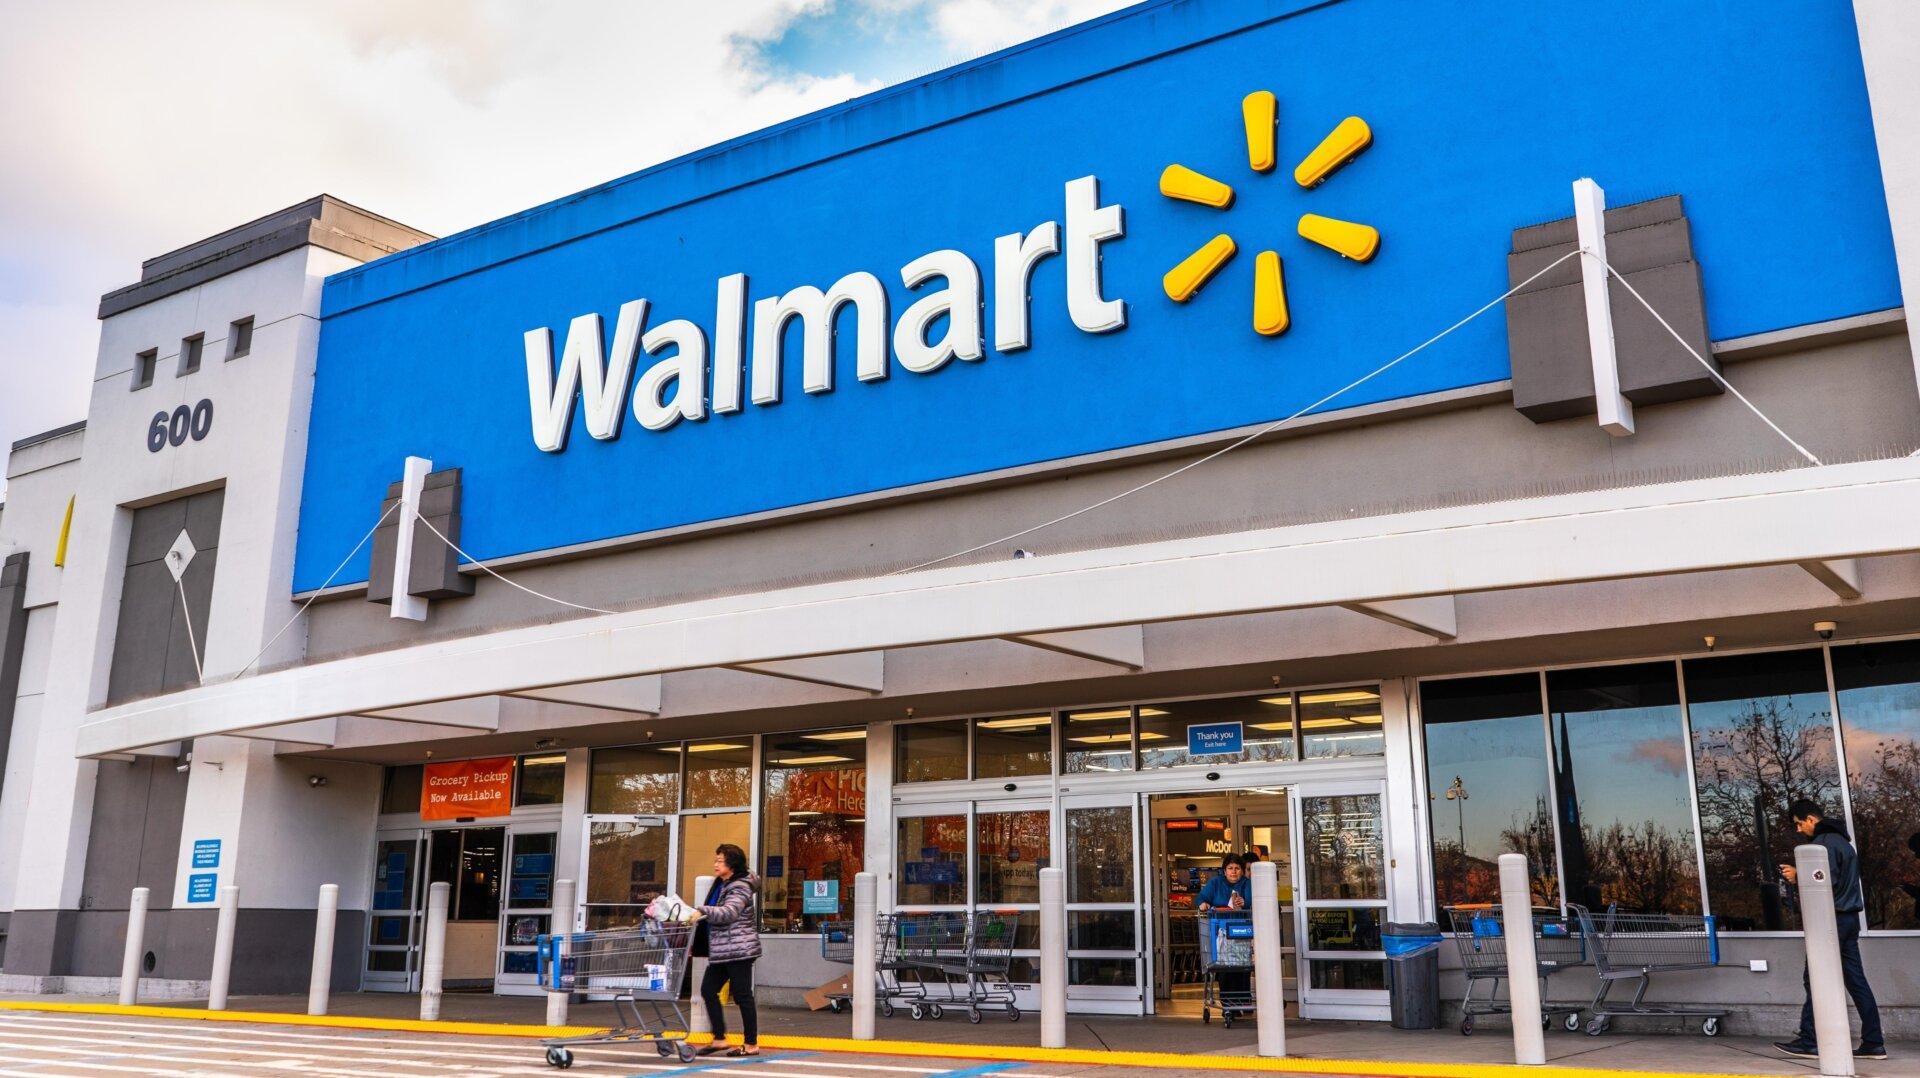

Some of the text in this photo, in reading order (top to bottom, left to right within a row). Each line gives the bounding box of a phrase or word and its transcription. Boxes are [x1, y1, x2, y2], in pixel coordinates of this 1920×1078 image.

[524, 175, 1125, 453] Walmart
[147, 398, 214, 453] 600
[1196, 731, 1234, 741] Thank you
[429, 771, 508, 787] Grocery Pickup
[430, 789, 502, 803] Now Available
[837, 790, 865, 812] Here
[1205, 839, 1248, 854] McDon's
